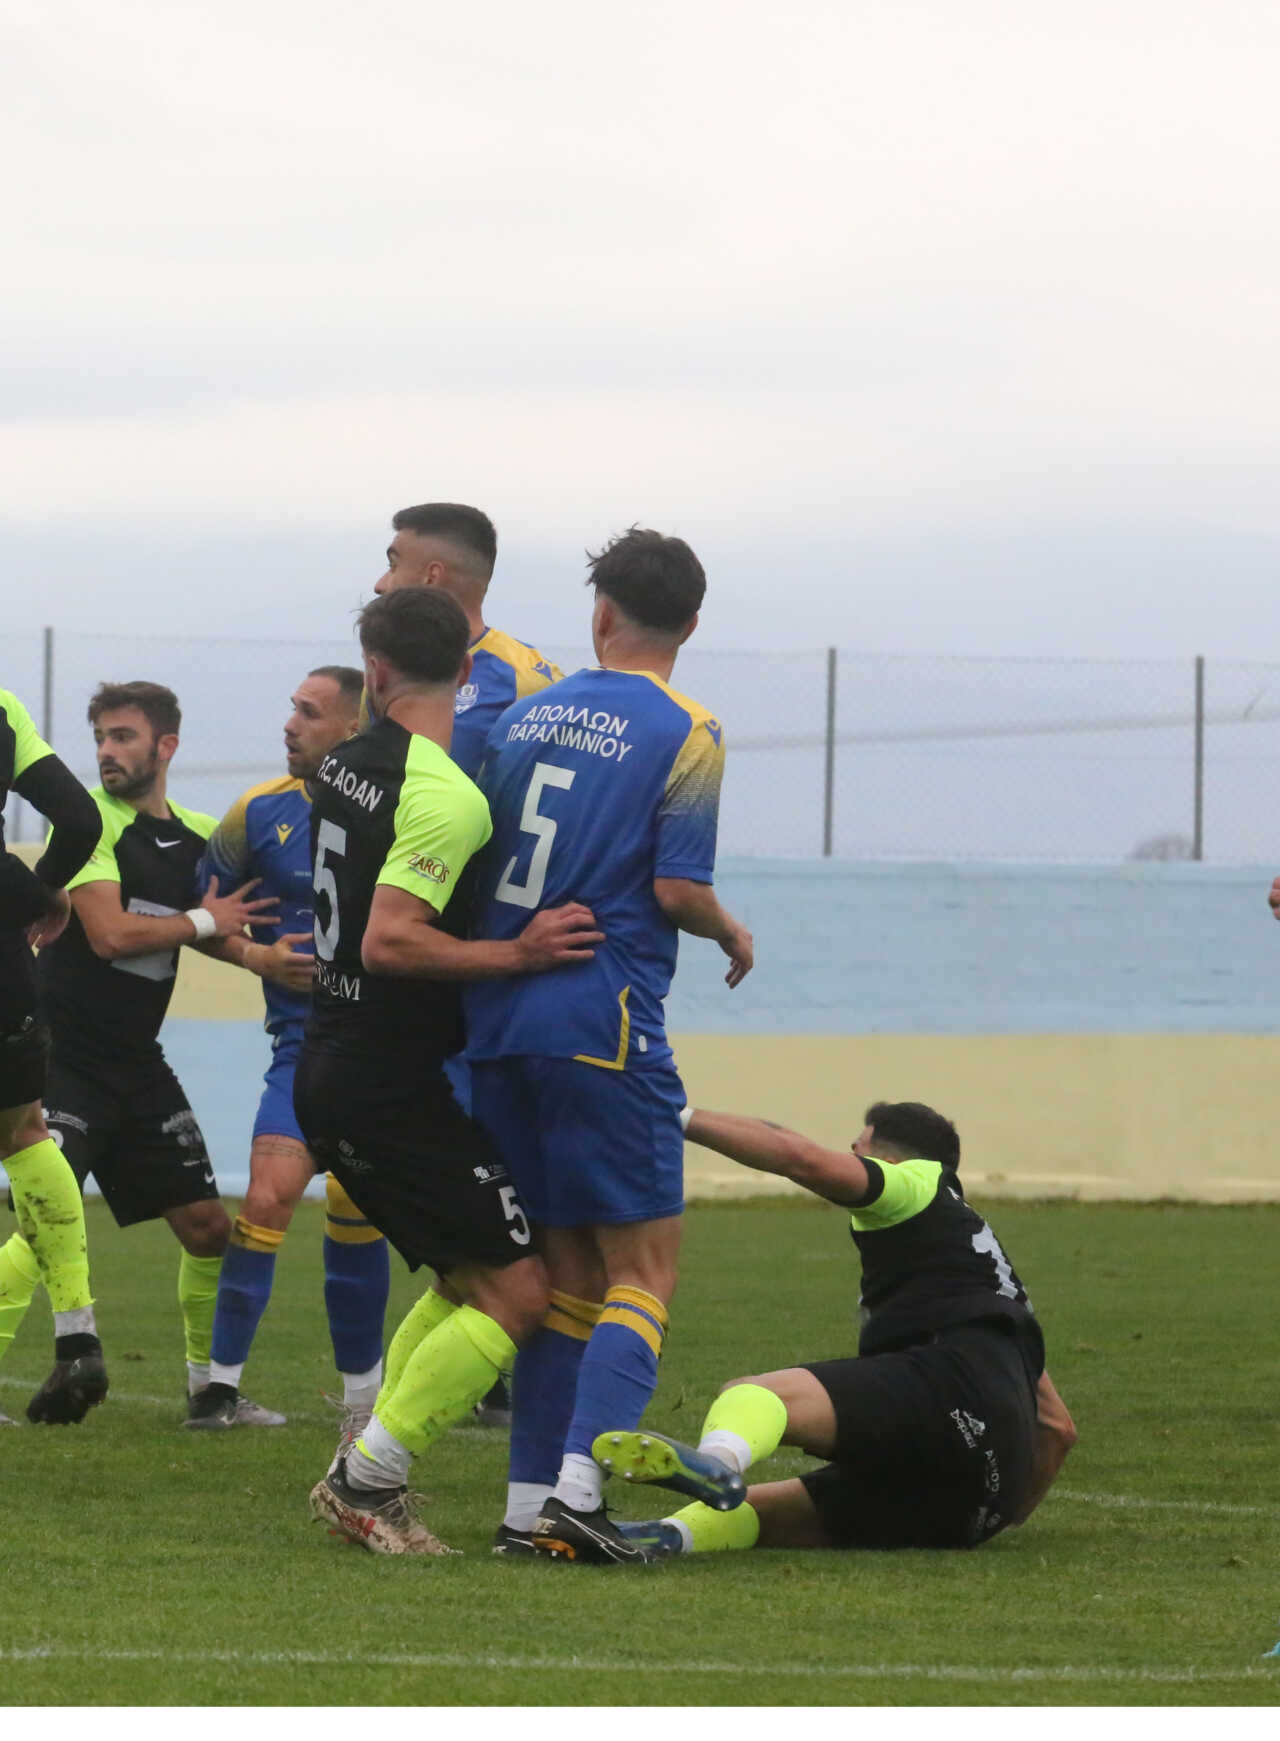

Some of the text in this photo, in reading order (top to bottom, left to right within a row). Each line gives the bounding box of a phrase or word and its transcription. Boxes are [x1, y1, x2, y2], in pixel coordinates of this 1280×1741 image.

[506, 723, 633, 762] ΠΑΡΑΛΙΜΝΙΟΥ
[521, 704, 629, 736] ΑΠΟΛΛΩΝ
[332, 765, 385, 812] AOAN
[494, 761, 577, 910] 5
[313, 818, 347, 962] 5
[498, 1185, 530, 1245] 5
